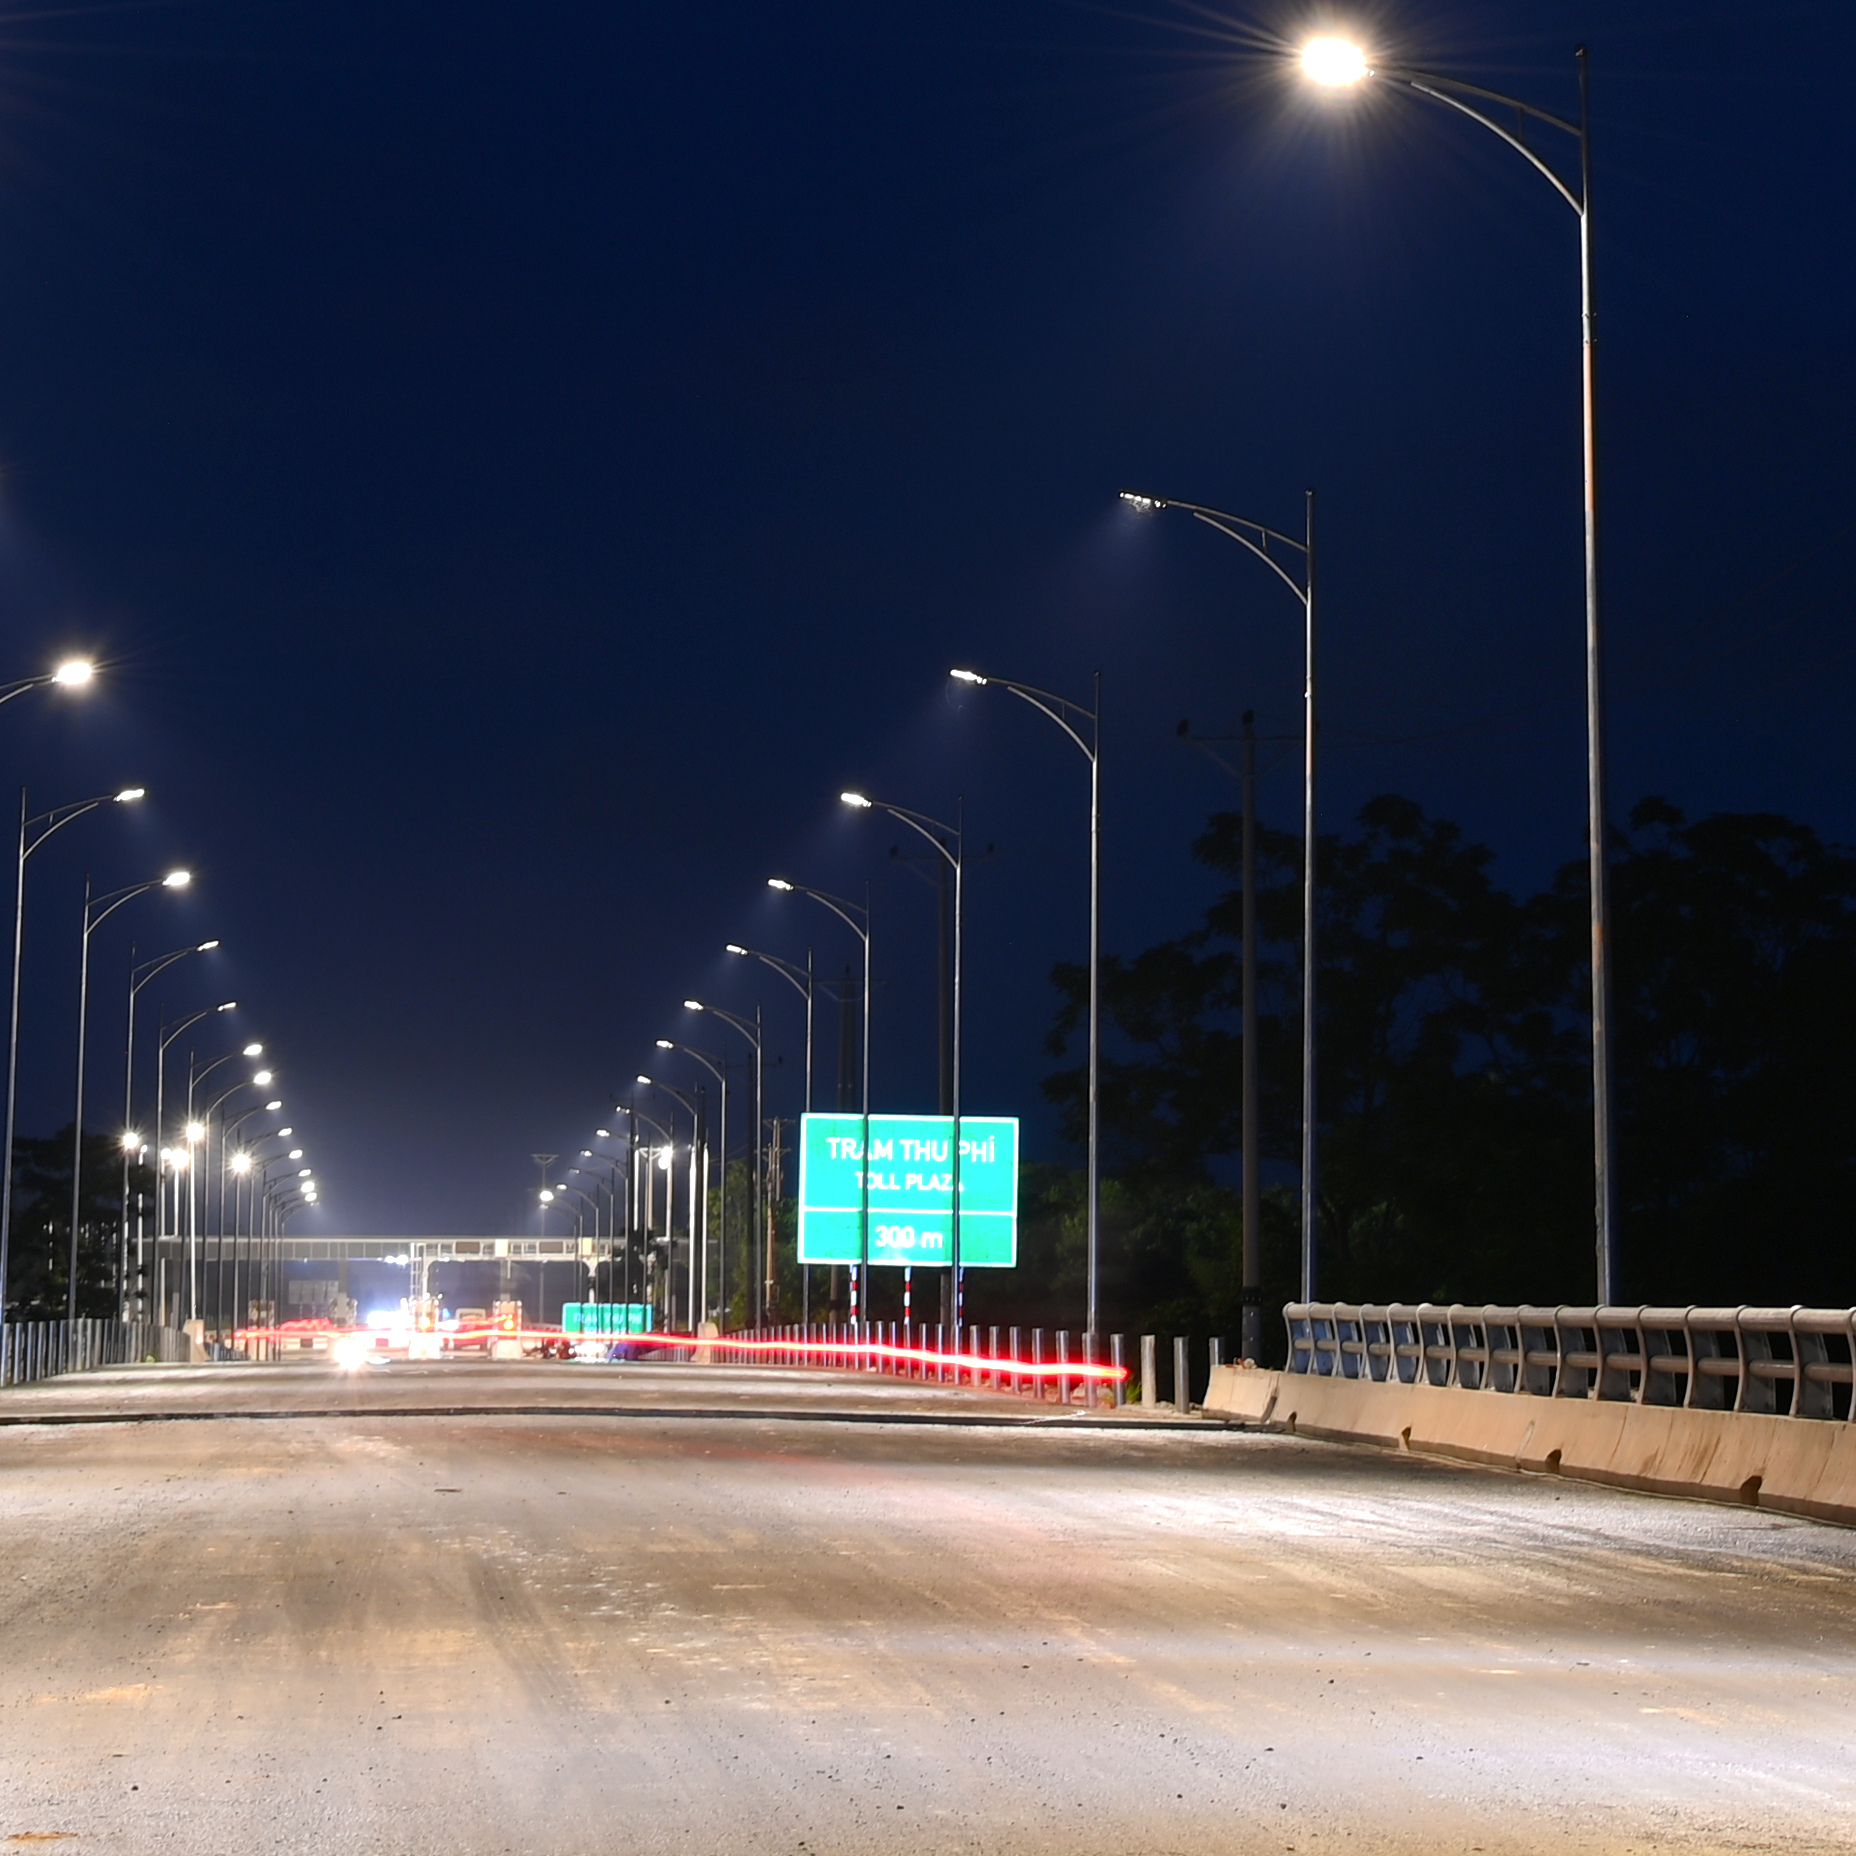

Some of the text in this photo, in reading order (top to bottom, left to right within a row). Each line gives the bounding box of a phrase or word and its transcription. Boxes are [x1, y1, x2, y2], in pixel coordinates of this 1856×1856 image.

[899, 1139, 948, 1162] THU
[854, 1171, 900, 1190] TOLL
[874, 1225, 943, 1249] 300 m
